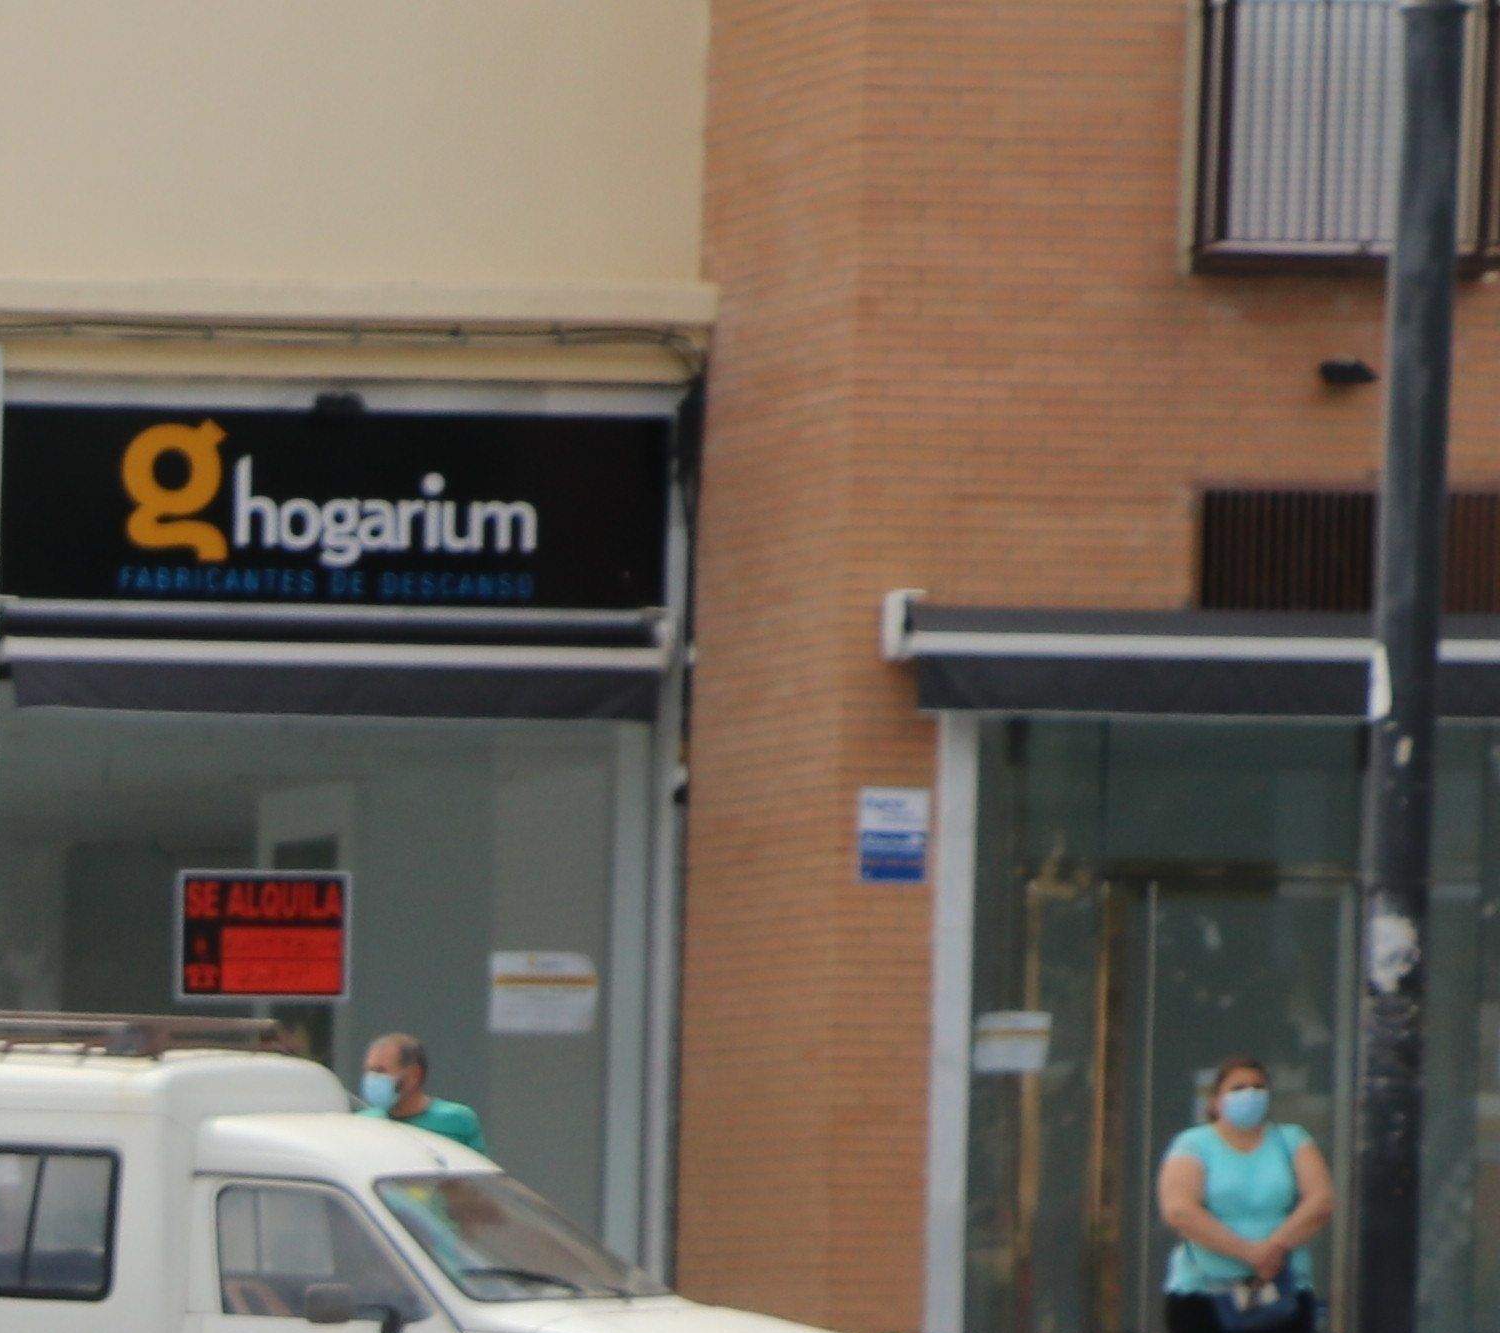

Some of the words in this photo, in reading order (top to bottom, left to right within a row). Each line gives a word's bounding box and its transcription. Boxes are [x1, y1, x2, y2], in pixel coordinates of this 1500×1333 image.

[232, 453, 539, 568] hogarium
[330, 571, 368, 595] DE
[185, 879, 220, 919] SE
[224, 880, 342, 919] ALQUILA
